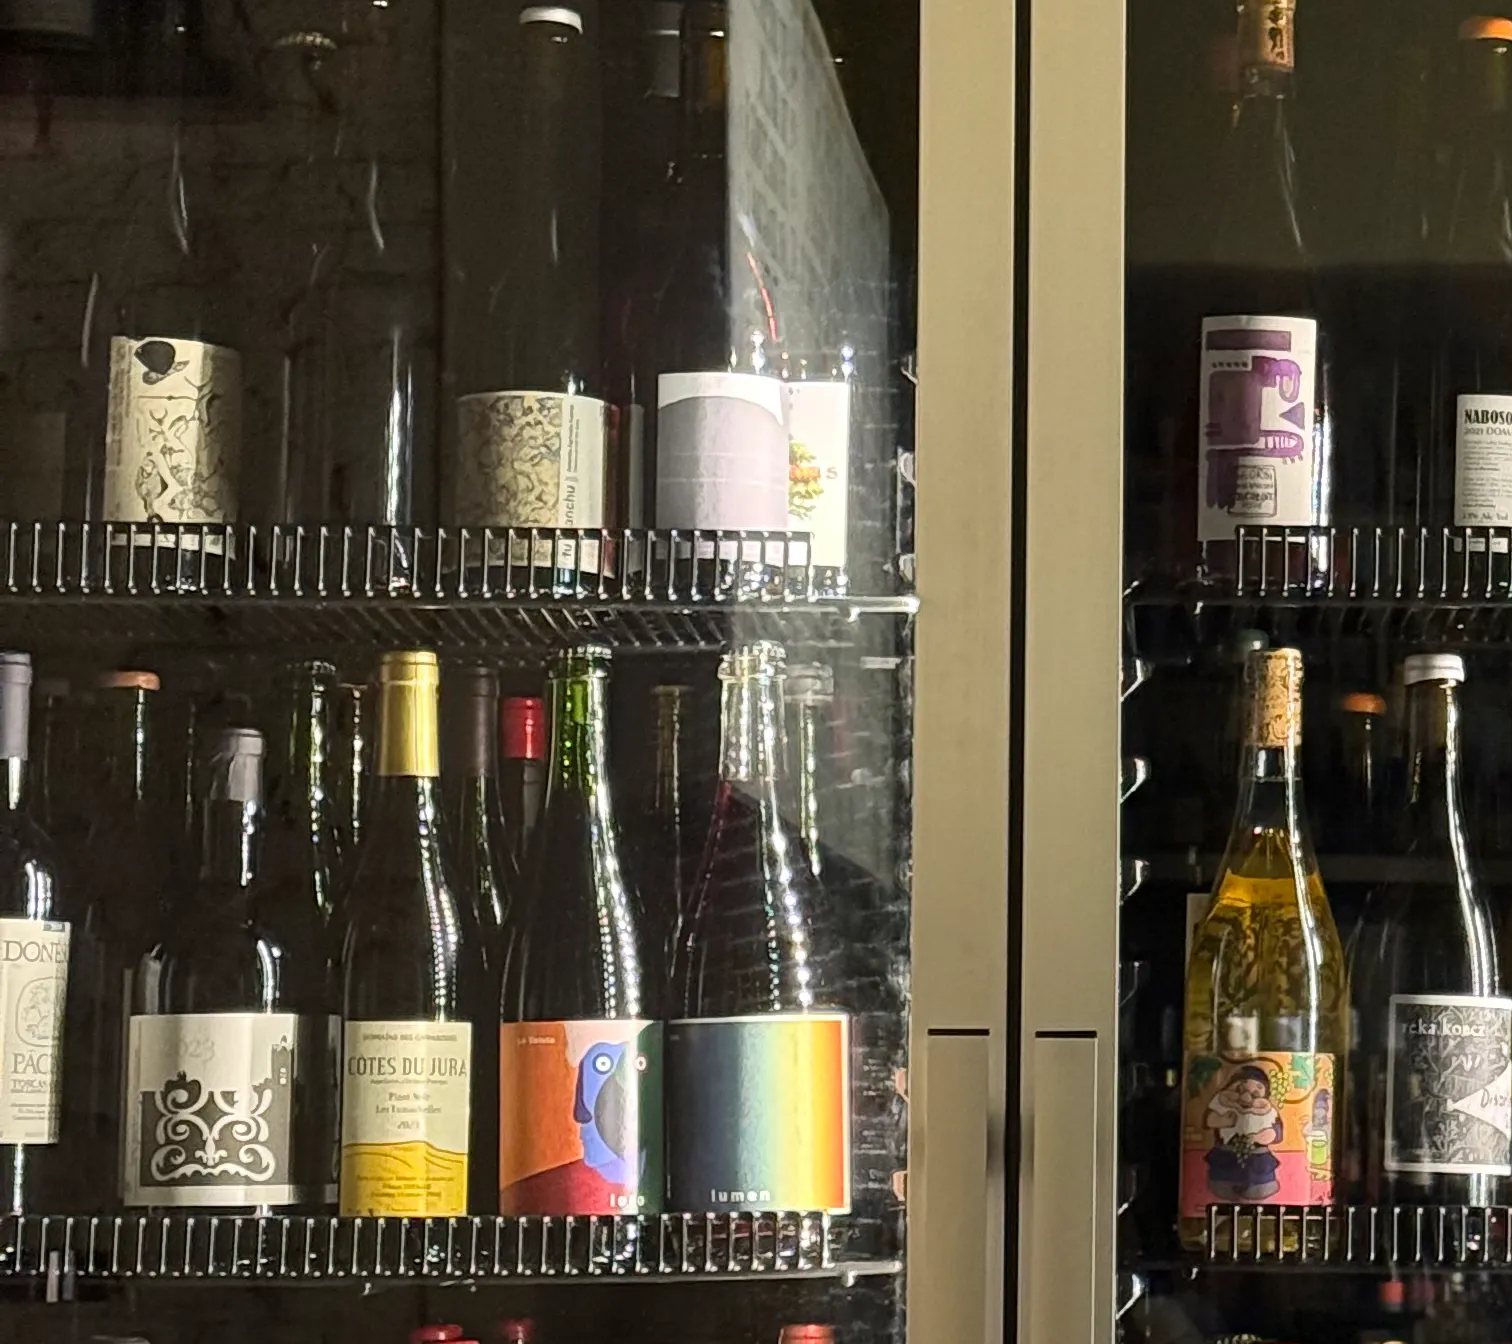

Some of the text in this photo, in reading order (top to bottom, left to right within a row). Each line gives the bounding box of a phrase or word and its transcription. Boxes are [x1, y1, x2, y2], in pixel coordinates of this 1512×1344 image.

[402, 1056, 425, 1077] DU
[430, 1056, 467, 1077] JURA
[710, 1188, 771, 1203] lumen
